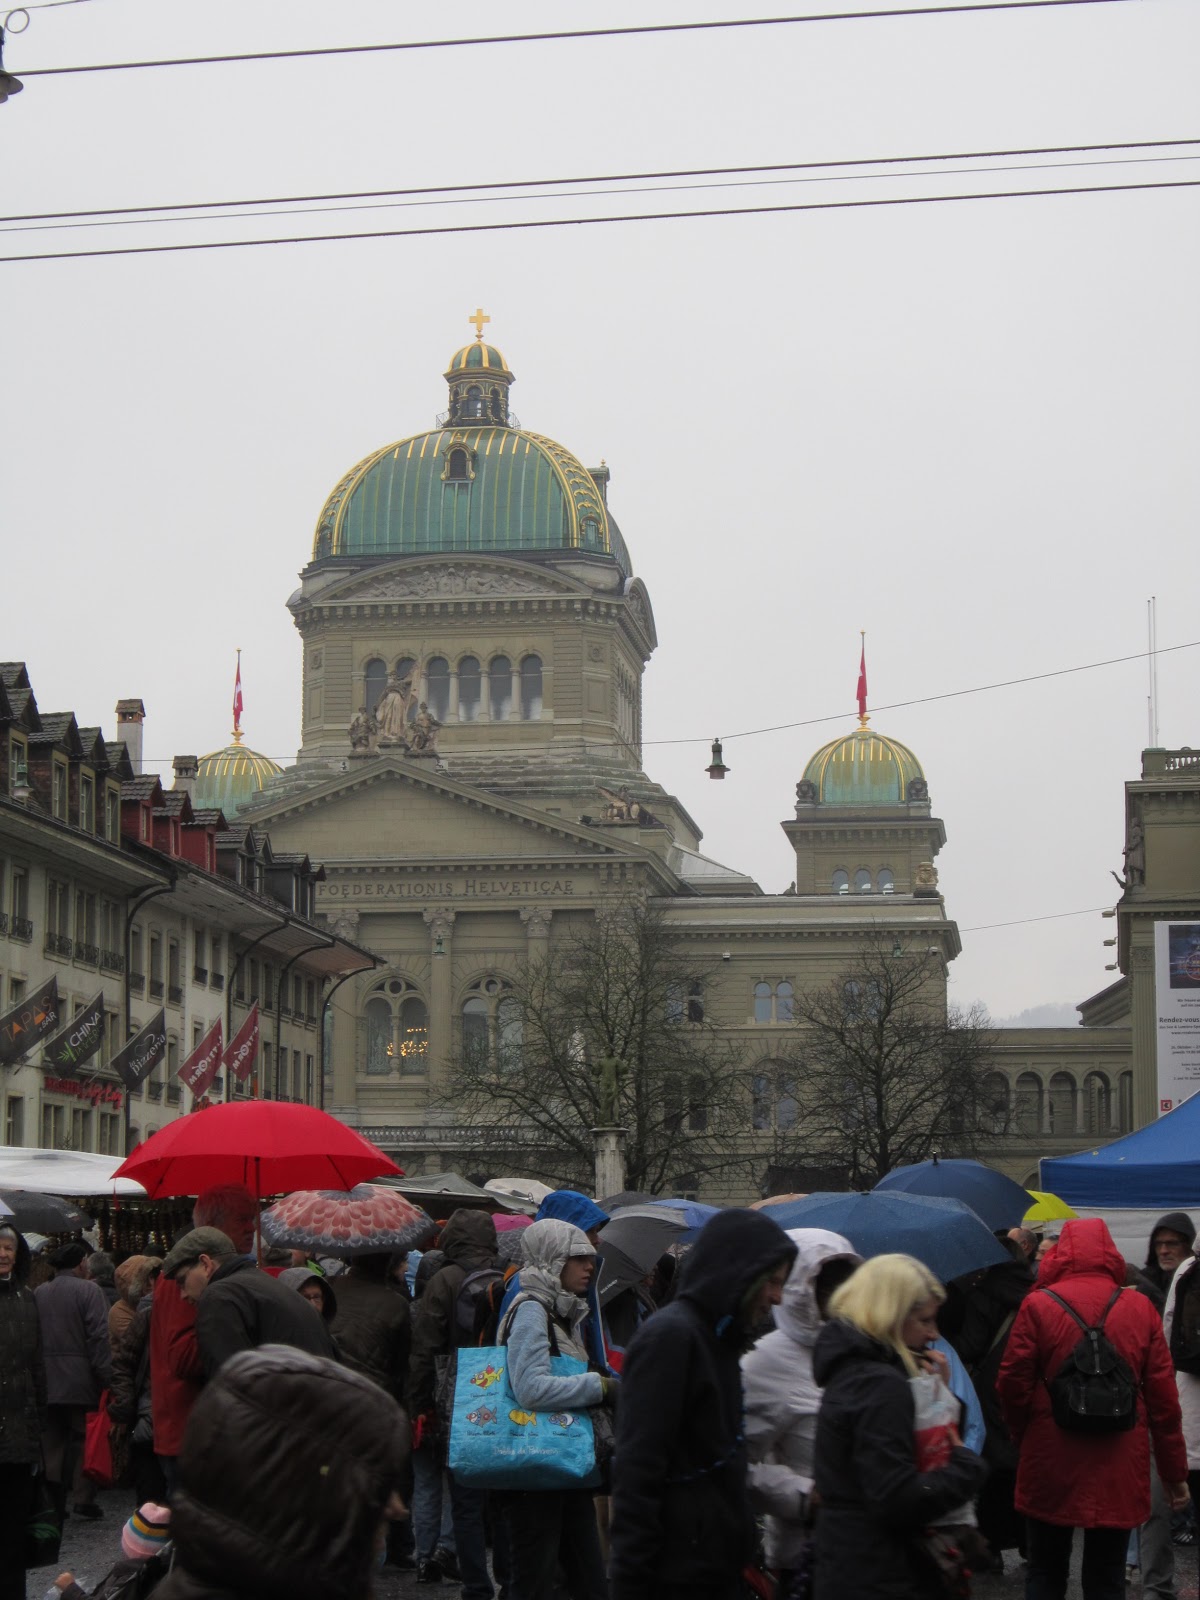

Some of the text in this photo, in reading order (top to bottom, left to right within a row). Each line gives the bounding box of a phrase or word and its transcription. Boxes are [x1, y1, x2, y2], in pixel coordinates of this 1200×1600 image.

[465, 880, 574, 893] HELVETICAE
[2, 996, 52, 1042] TAPAS
[41, 1011, 57, 1028] BAR
[69, 1012, 101, 1047] CHINA
[132, 1034, 166, 1076] pizzeria
